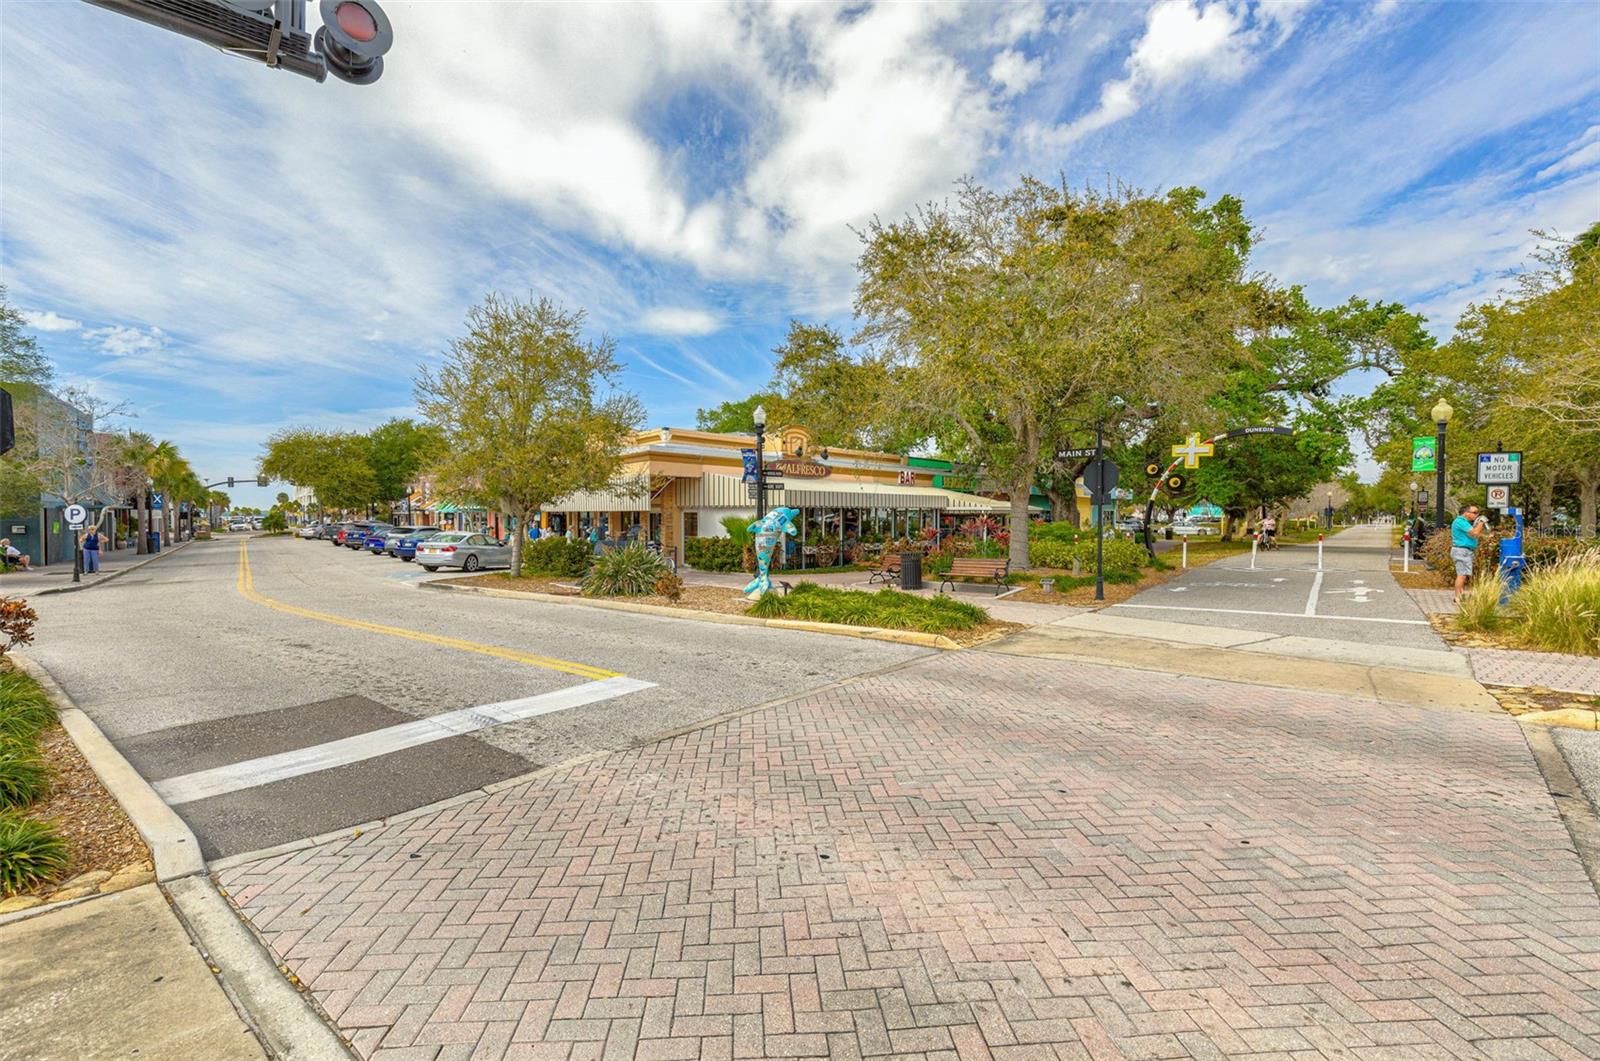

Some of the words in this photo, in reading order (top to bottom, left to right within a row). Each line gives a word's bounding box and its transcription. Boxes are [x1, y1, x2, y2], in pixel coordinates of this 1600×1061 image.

[1058, 450, 1082, 458] MAIN
[786, 463, 826, 476] ALFRESCO
[899, 471, 915, 484] BAR
[70, 509, 81, 520] P
